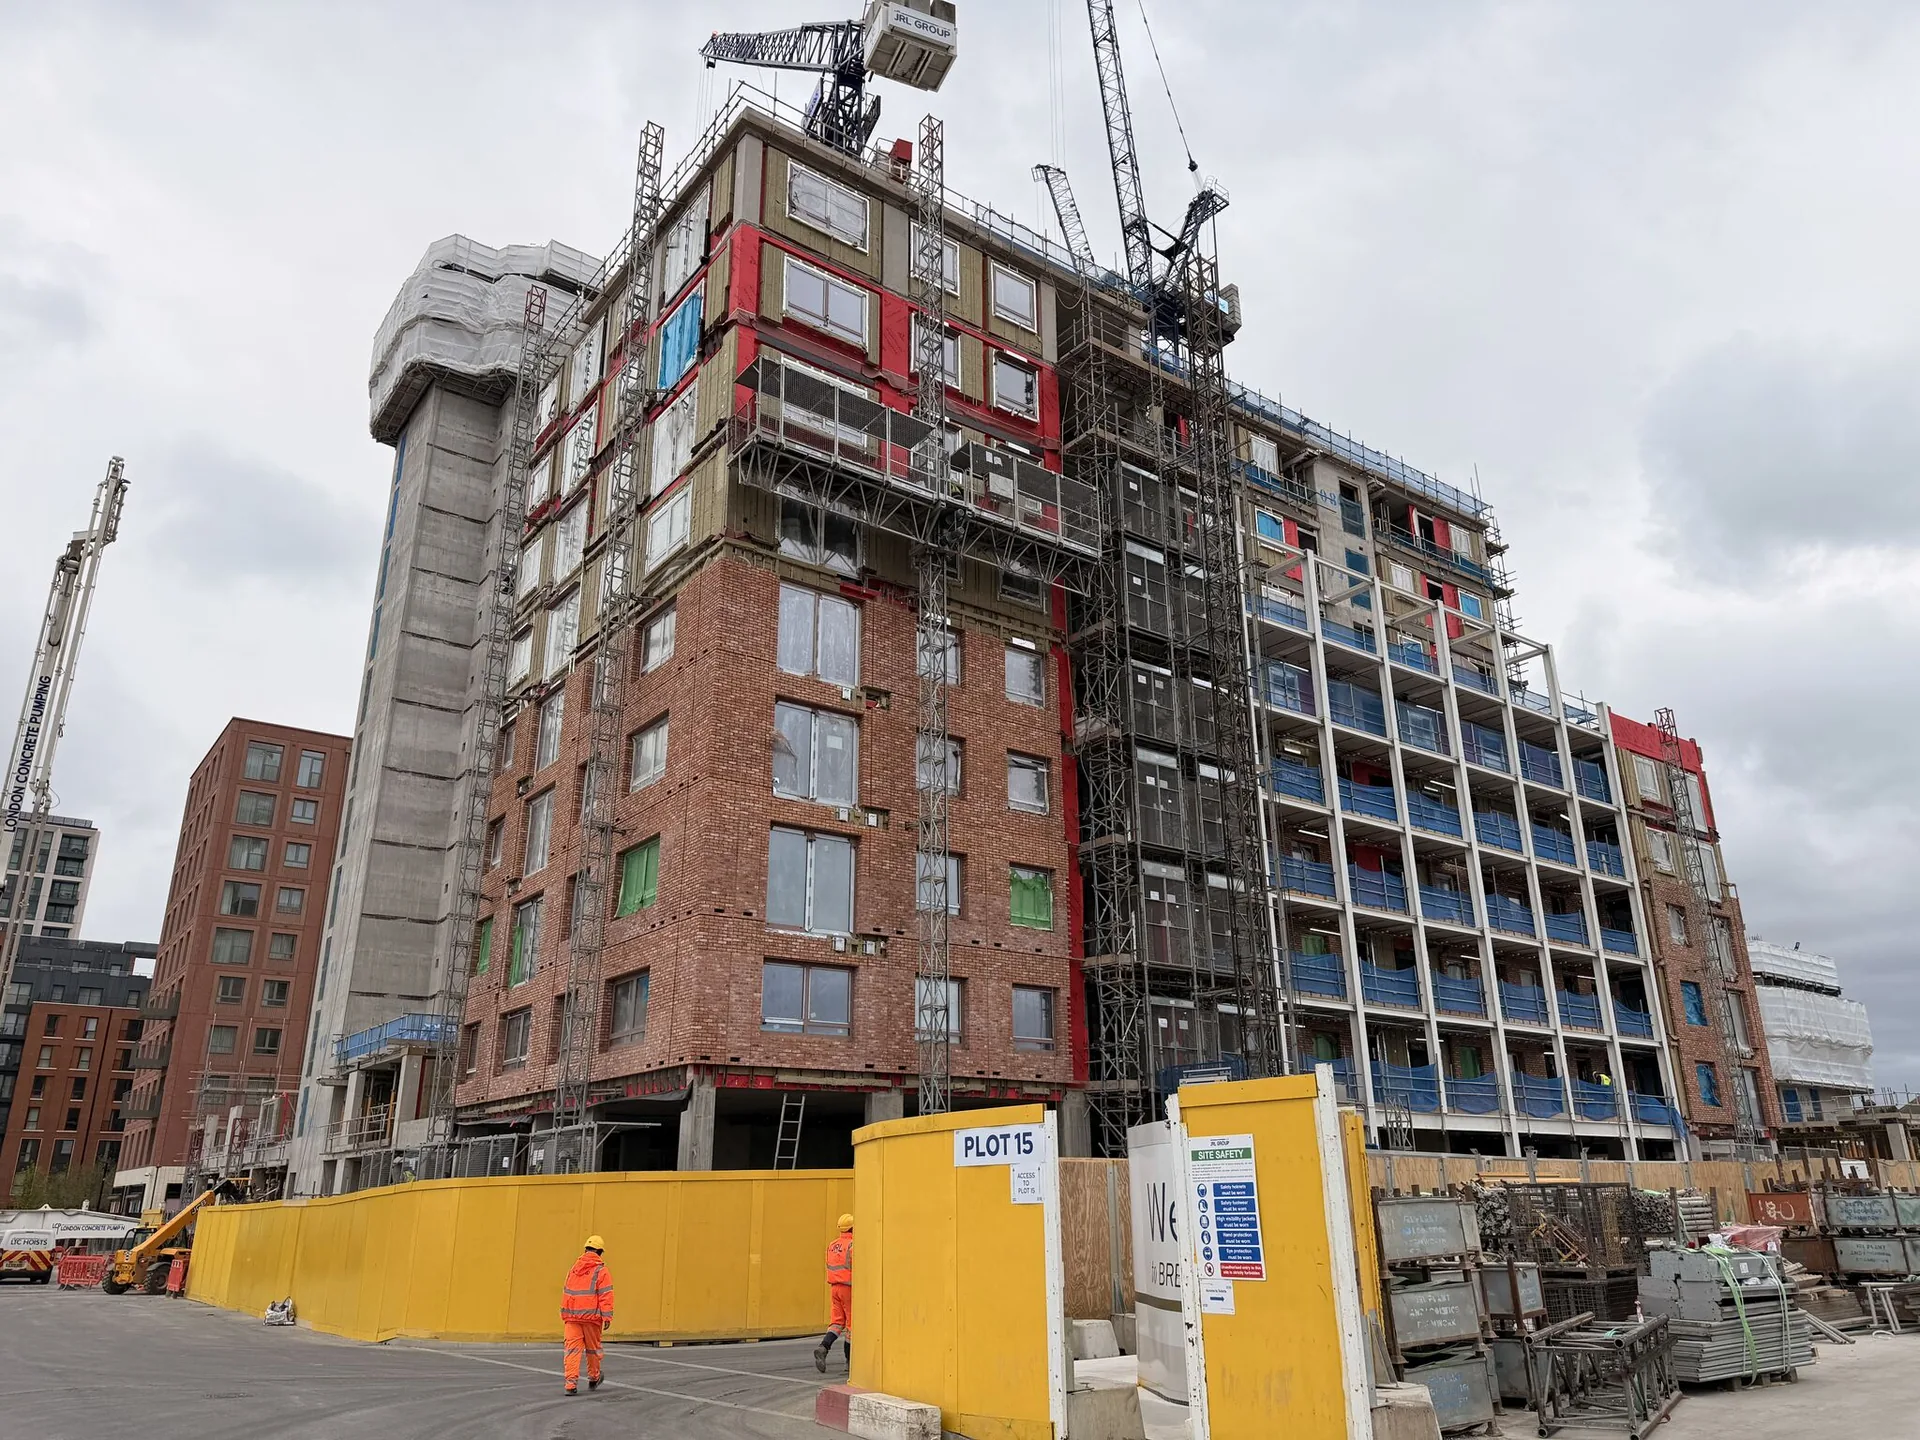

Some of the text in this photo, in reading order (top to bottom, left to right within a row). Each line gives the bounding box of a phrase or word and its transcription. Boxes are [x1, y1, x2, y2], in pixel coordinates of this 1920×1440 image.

[894, 13, 951, 39] JRL GROUP
[4, 675, 52, 832] LONDON CONCRETE PUMPING
[964, 1131, 1034, 1158] PLOT 15
[1198, 1149, 1244, 1160] SITE SAFETY
[1017, 1171, 1036, 1179] ACCESS
[1022, 1179, 1030, 1187] TO
[10, 1238, 48, 1246] LTC HOISTS
[1151, 1260, 1158, 1285] to
